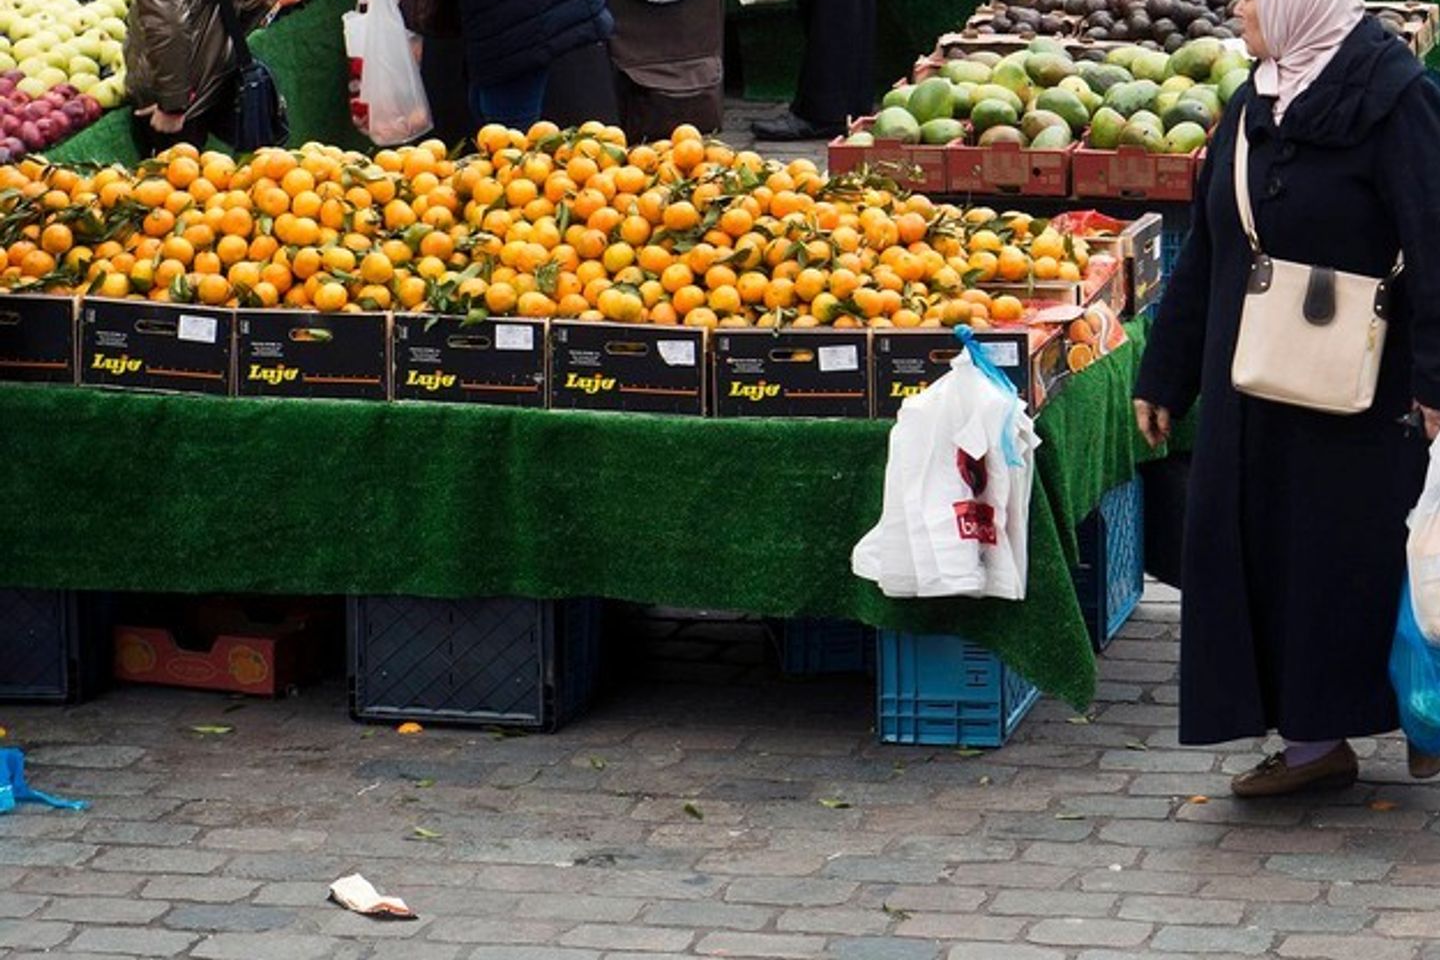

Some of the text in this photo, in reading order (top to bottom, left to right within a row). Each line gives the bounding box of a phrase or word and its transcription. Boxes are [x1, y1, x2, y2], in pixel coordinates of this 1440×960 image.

[91, 353, 142, 375] Lujo
[248, 363, 299, 385] Lujo
[406, 369, 457, 391] Lujo
[564, 372, 617, 394] Lujo
[728, 380, 781, 401] Lujo
